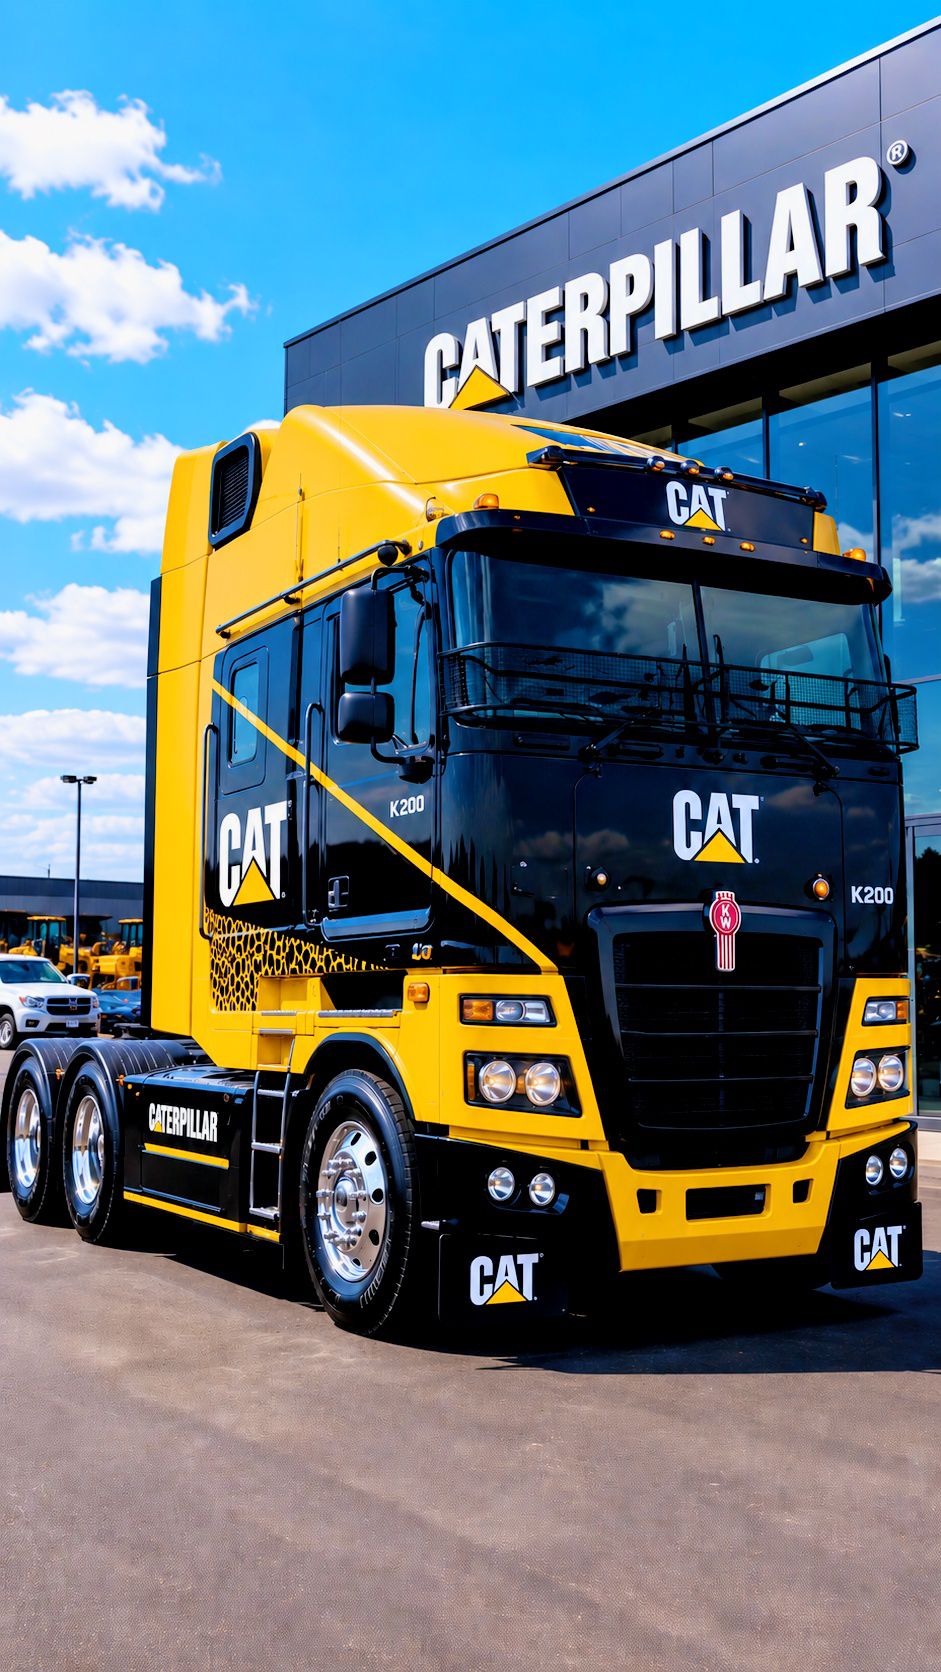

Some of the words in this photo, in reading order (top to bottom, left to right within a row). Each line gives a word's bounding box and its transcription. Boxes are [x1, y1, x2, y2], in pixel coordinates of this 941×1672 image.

[424, 156, 886, 408] CATERPILLAR
[666, 480, 727, 531] CAT
[389, 794, 425, 818] K200
[673, 789, 760, 864] CAT
[219, 800, 288, 907] CAT
[850, 885, 894, 905] K200
[148, 1102, 218, 1143] CATERPILLAR
[853, 1225, 903, 1272] CAT
[469, 1252, 539, 1306] CAT
